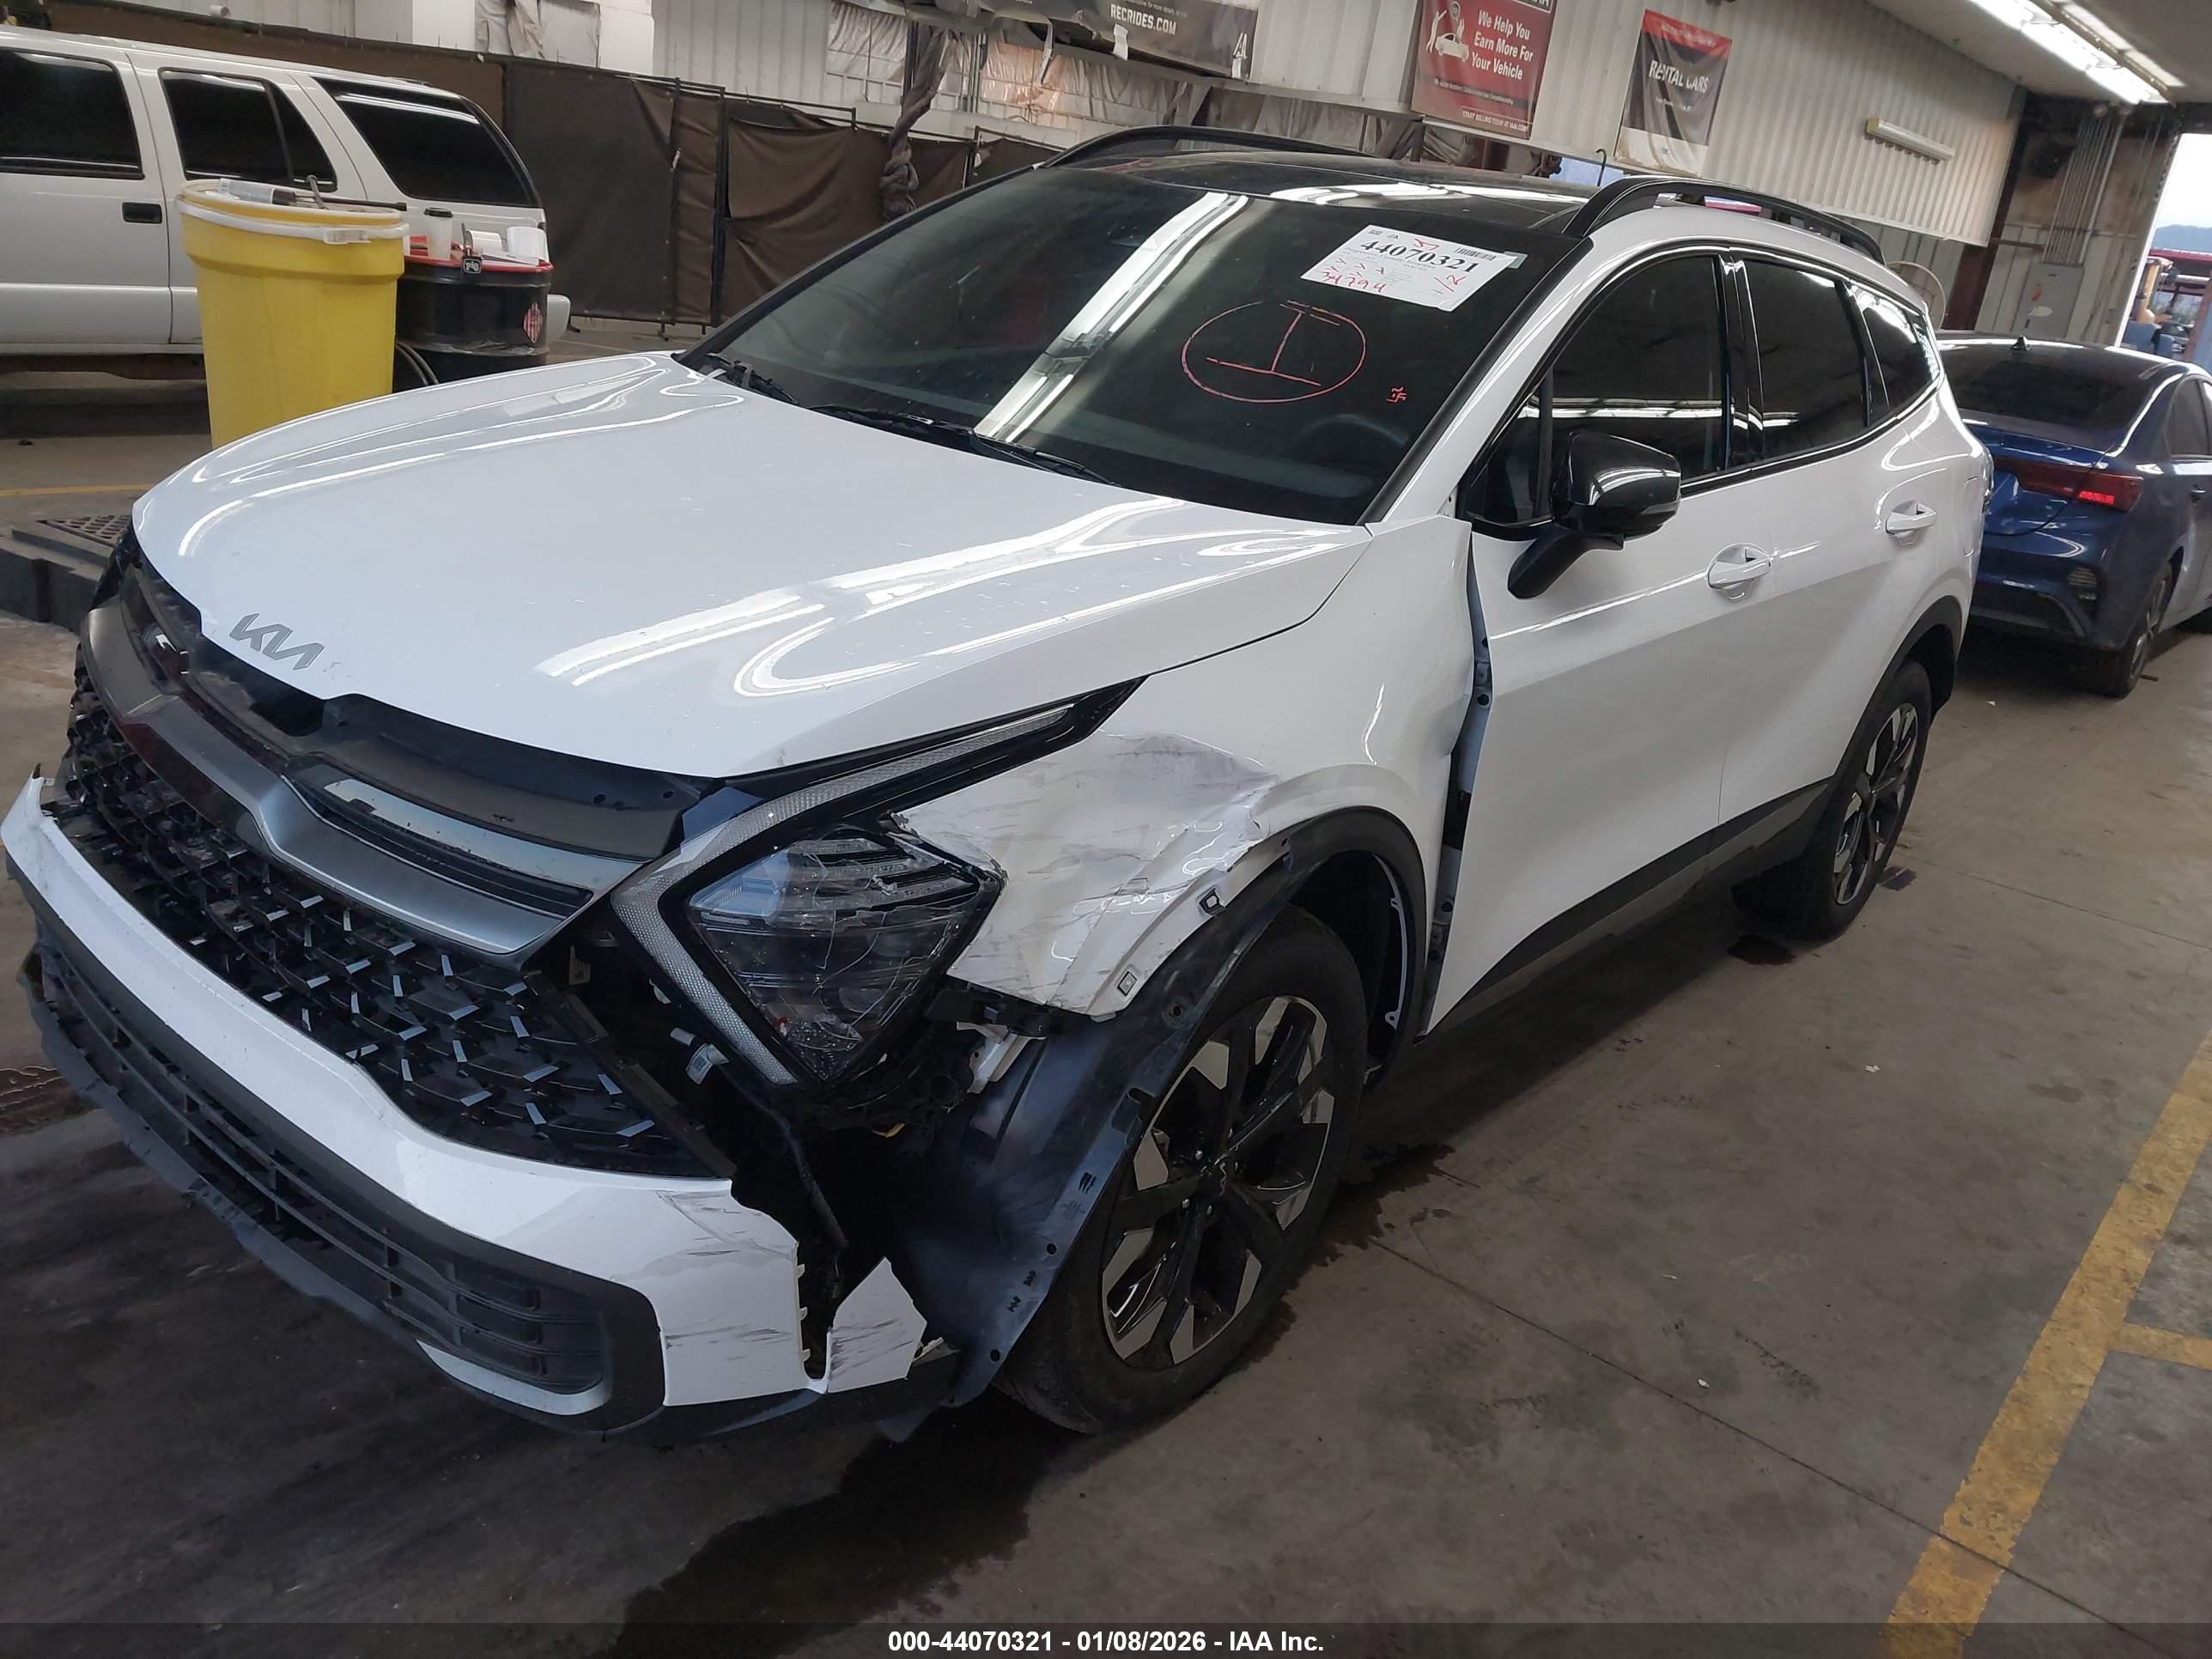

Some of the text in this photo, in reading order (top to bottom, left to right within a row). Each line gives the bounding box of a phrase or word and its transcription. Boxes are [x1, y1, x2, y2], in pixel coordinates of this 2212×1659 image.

[1110, 3, 1176, 35] RECRIDES.COM
[1478, 9, 1530, 40] We Help You
[1474, 31, 1534, 62] Earn More For
[1472, 52, 1523, 80] Your Vehicle
[1649, 59, 1683, 87] RENTAL
[1360, 240, 1479, 272] 44070321
[229, 612, 325, 671] KIA
